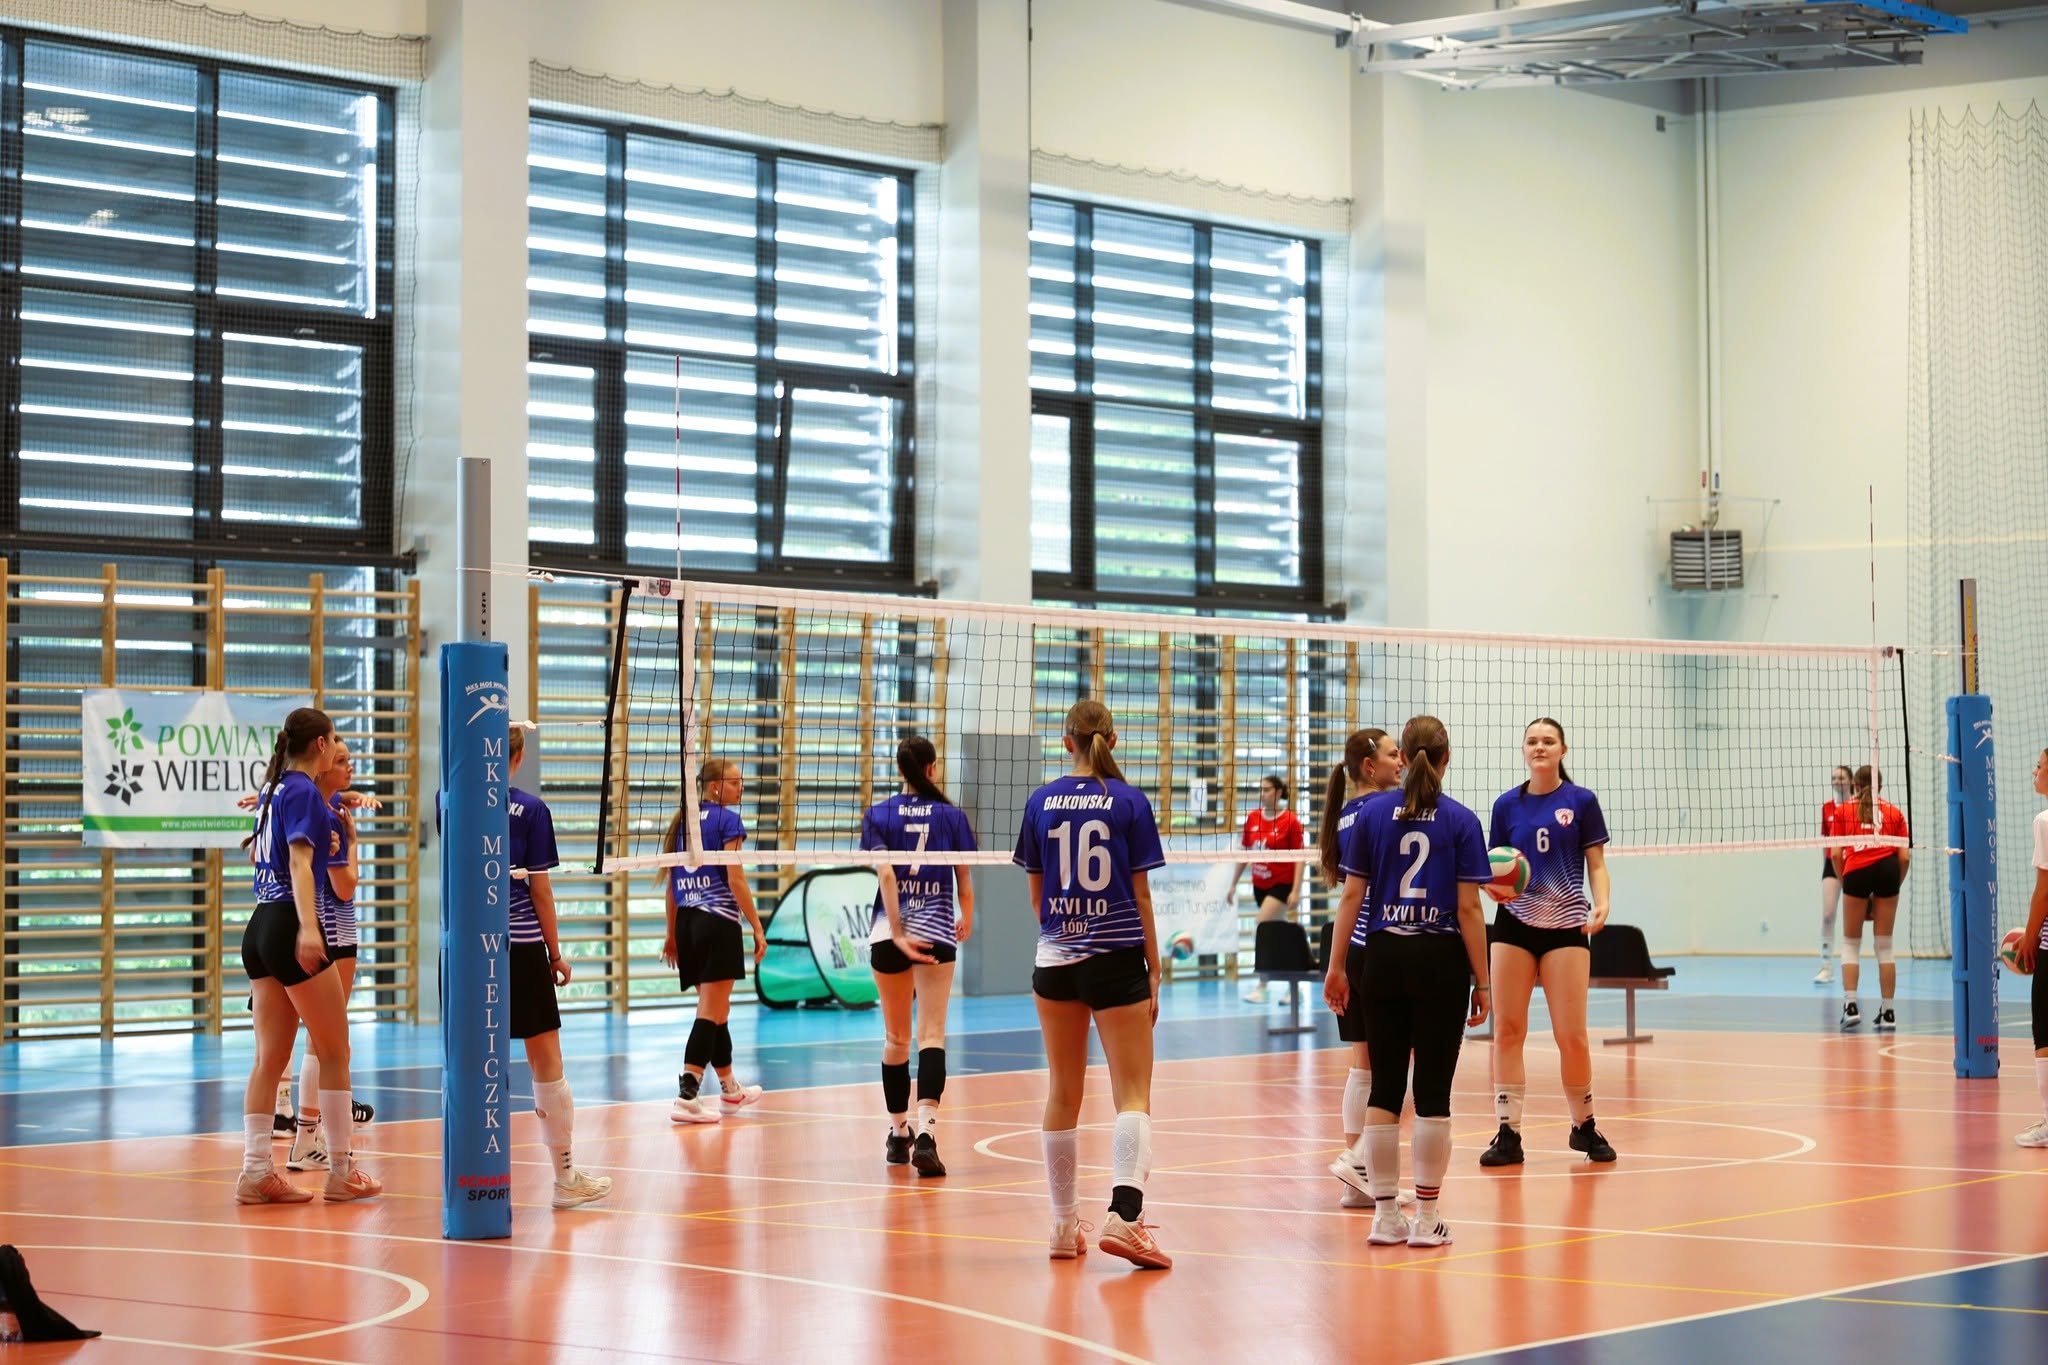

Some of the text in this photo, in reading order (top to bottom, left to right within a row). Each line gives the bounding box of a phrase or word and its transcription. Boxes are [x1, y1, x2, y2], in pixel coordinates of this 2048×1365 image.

[157, 724, 282, 756] POWIAT
[153, 759, 268, 792] WIELIC
[904, 823, 930, 876] 7
[1047, 819, 1112, 893] 16
[1536, 827, 1550, 853] 6
[1399, 830, 1431, 899] 2
[924, 881, 941, 896] LO
[1086, 898, 1109, 916] LO
[1382, 904, 1415, 921] XXVI
[480, 737, 503, 1154] MKS MOS WIELICZKA
